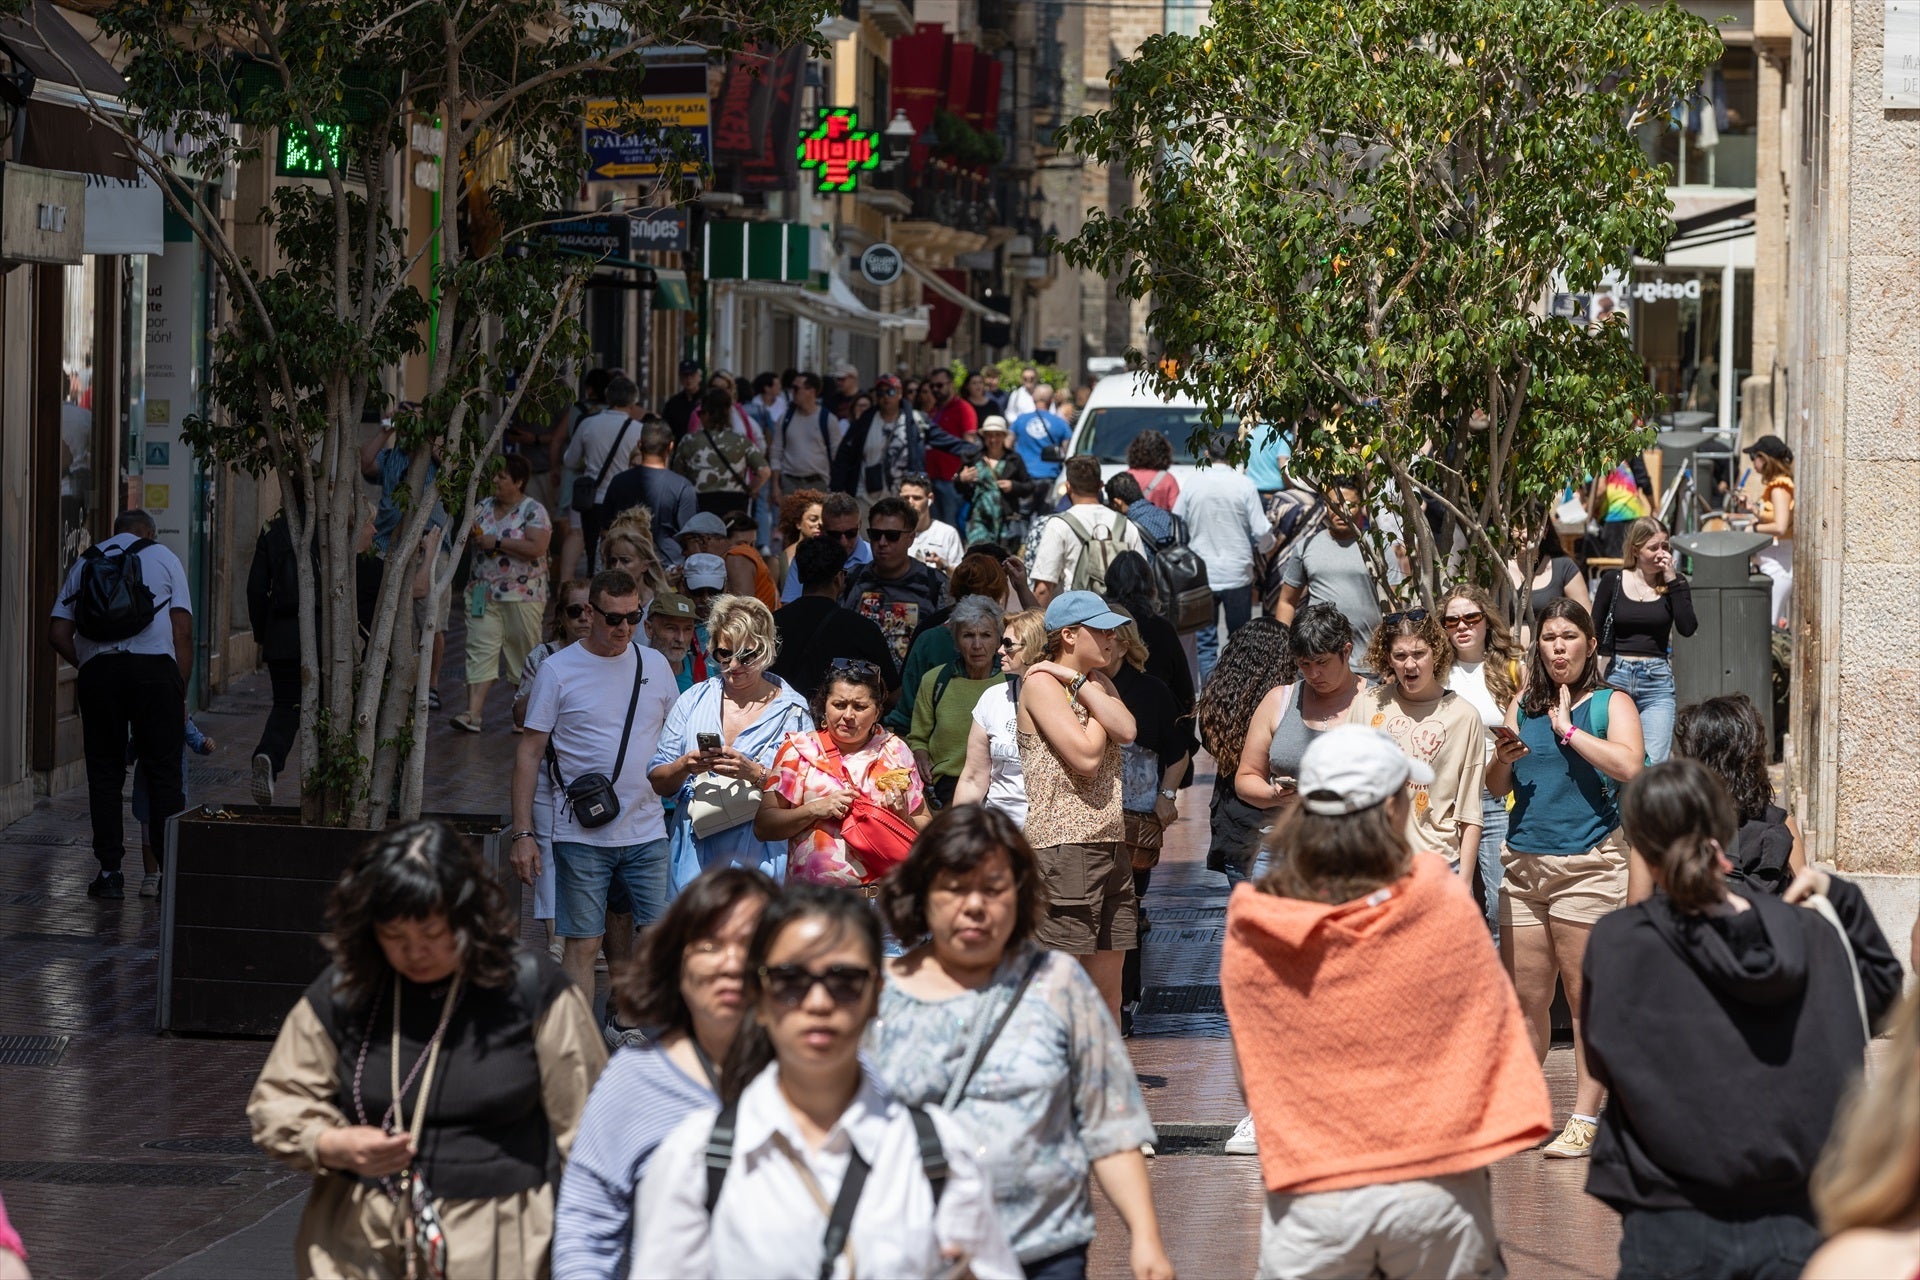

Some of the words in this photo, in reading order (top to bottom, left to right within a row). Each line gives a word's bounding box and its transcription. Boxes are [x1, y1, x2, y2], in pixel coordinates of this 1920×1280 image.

[664, 103, 672, 113] Y
[674, 101, 706, 113] PLATA
[630, 219, 679, 241] snipes
